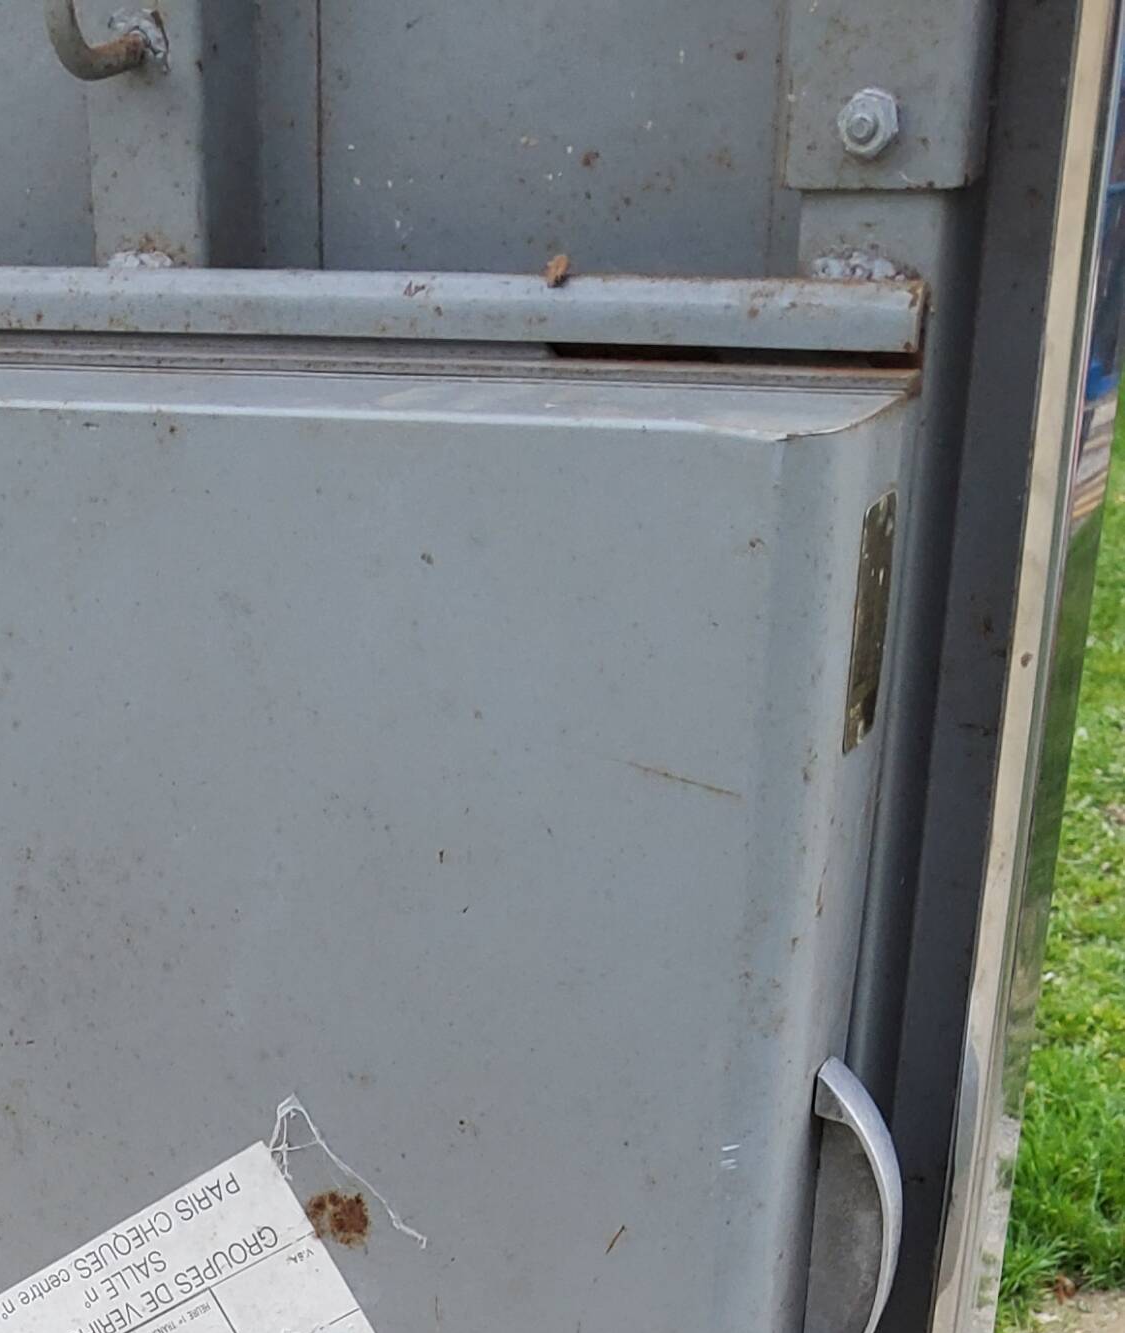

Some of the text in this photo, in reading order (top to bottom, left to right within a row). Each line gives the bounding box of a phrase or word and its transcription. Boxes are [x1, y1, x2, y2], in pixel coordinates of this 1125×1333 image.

[175, 1172, 241, 1221] PARIS
[74, 1211, 172, 1279] CHEQUES
[174, 1226, 278, 1294] GROUPES
[18, 1269, 70, 1305] centre
[100, 1250, 167, 1300] SALLE
[140, 1282, 174, 1313] DE
[186, 1302, 211, 1320] HEURE
